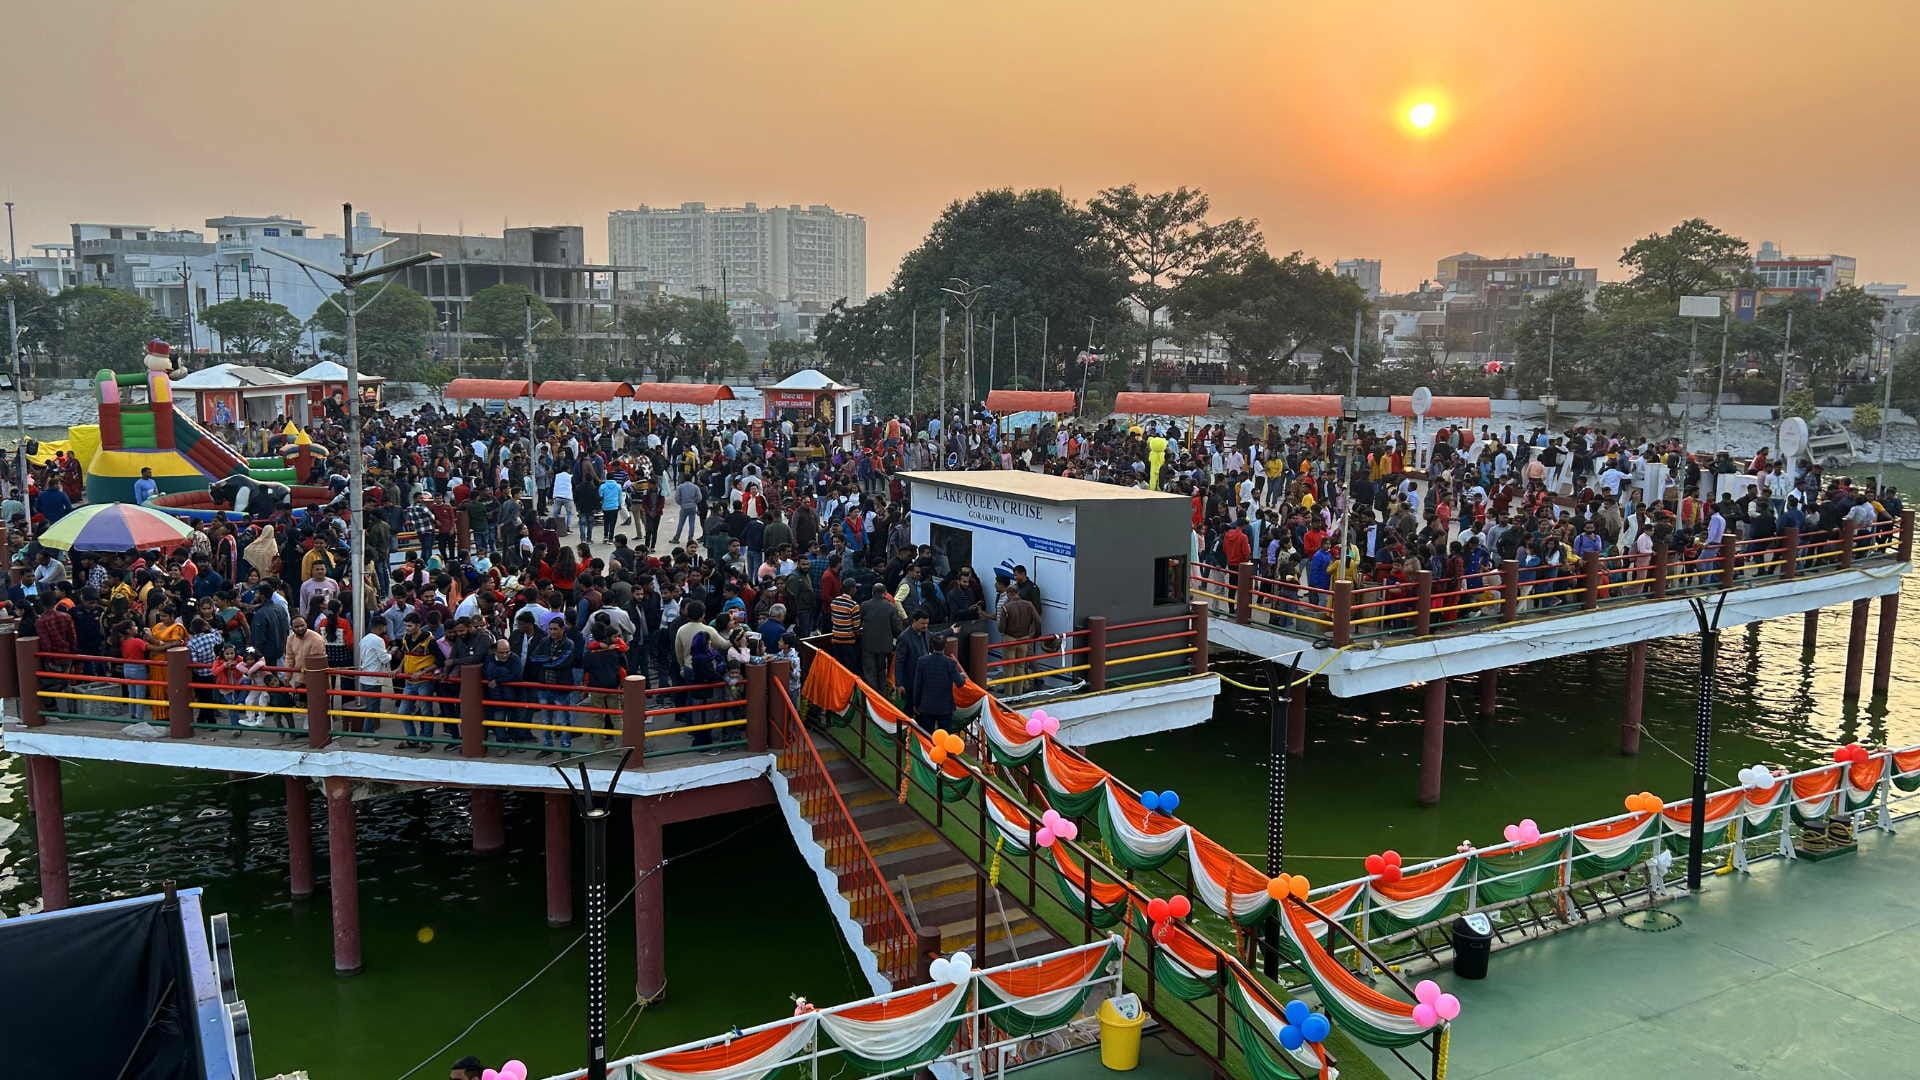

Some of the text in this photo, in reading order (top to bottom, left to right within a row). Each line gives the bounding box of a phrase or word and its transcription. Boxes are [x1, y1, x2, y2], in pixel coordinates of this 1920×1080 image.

[936, 487, 1043, 520] LAKE QUEEN CRUISE
[968, 510, 1005, 525] GORAKHPUR
